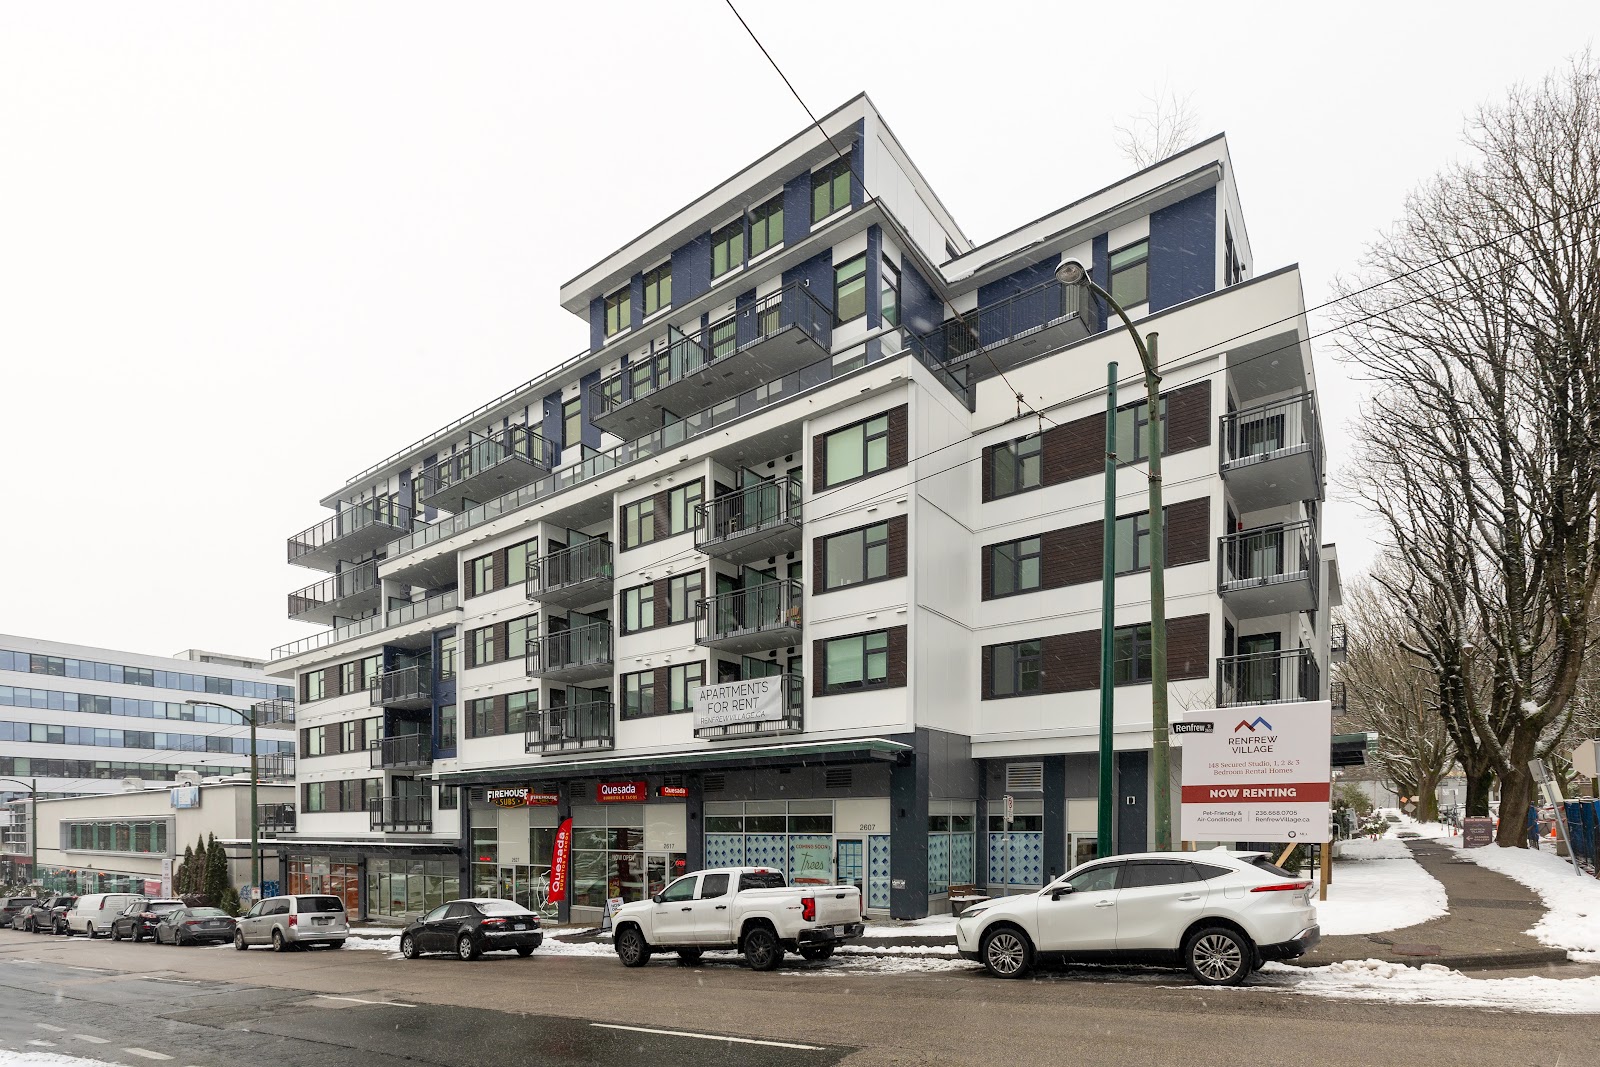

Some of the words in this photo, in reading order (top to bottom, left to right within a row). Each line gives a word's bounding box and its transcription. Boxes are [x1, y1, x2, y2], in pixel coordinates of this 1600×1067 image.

[699, 681, 769, 701] APARTMENTS
[707, 701, 729, 714] FOR
[732, 697, 760, 711] RENT
[1175, 723, 1205, 733] Renfrew
[1228, 735, 1278, 745] RENFREW
[1231, 745, 1274, 754] VILLAGE
[601, 784, 636, 795] Quesada
[664, 786, 686, 794] Quesada
[1209, 788, 1240, 798] NOW
[1242, 787, 1297, 798] RENTING
[487, 788, 529, 803] FIREHOUSE
[500, 798, 516, 806] SUBS
[552, 831, 566, 893] Quesada
[800, 851, 824, 876] Trees
